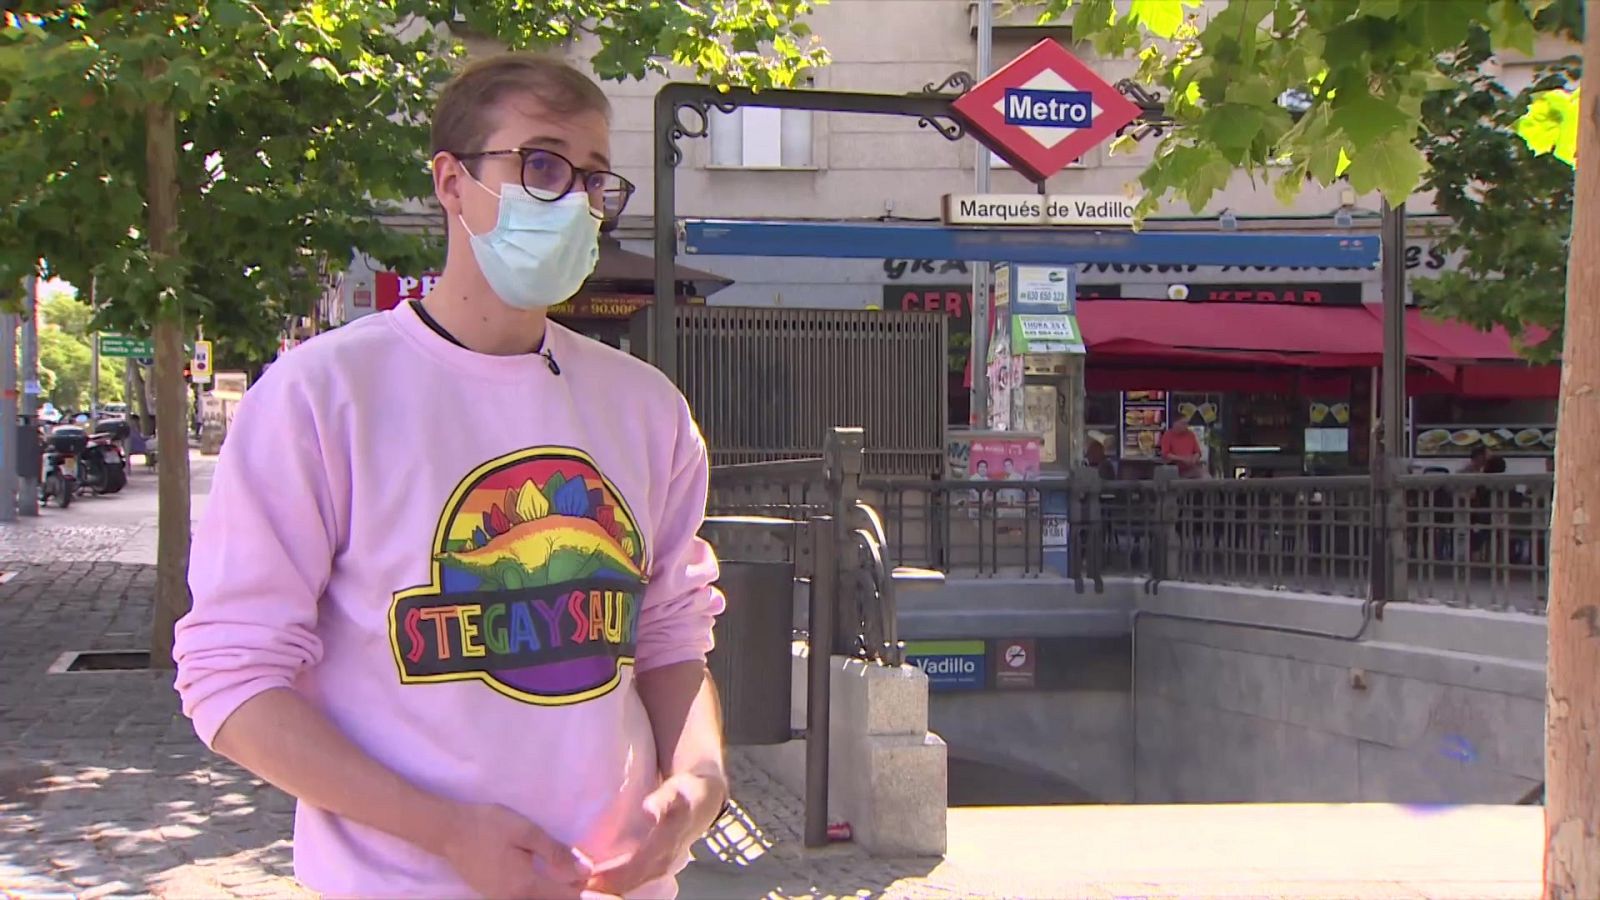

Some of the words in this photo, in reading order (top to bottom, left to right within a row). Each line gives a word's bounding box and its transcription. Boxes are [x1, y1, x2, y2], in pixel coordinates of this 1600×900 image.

[1009, 94, 1087, 122] Metro
[960, 200, 1041, 220] Marqués
[1046, 201, 1069, 218] de
[1074, 201, 1134, 218] Vadillo
[916, 657, 975, 674] Vadillo
